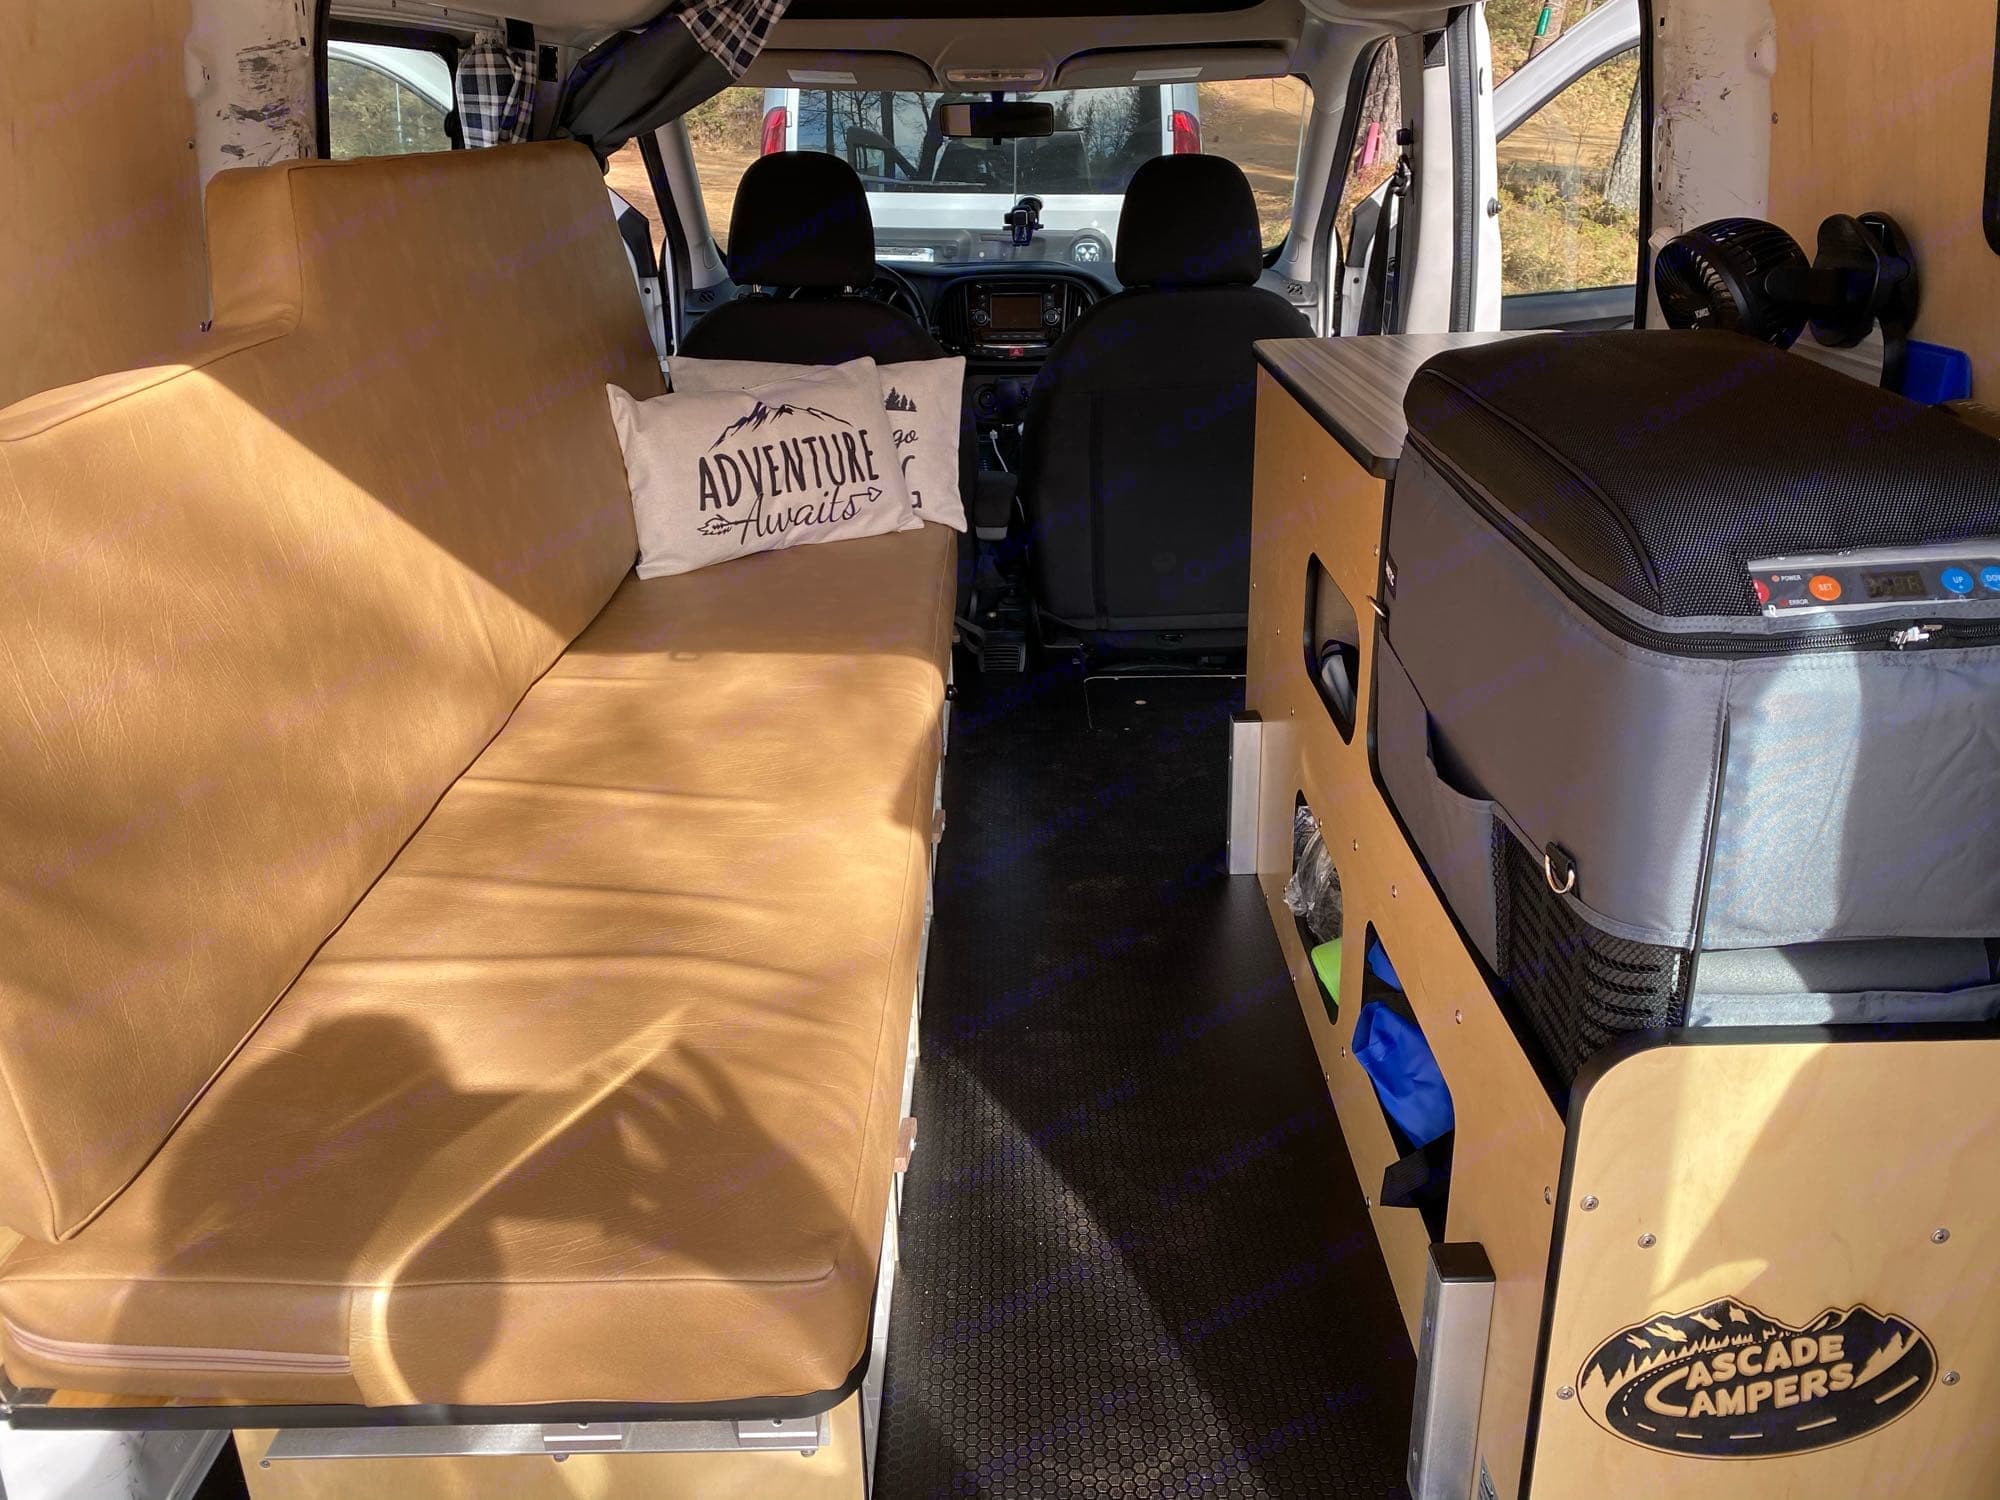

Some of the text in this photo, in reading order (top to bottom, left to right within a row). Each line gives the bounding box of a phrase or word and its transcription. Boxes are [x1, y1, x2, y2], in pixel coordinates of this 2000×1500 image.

[699, 429, 879, 511] ADVENTURE
[739, 485, 861, 545] Awaits
[1818, 583, 1833, 592] SET
[1952, 576, 1964, 584] UP
[1644, 1363, 1854, 1418] CAMPERS
